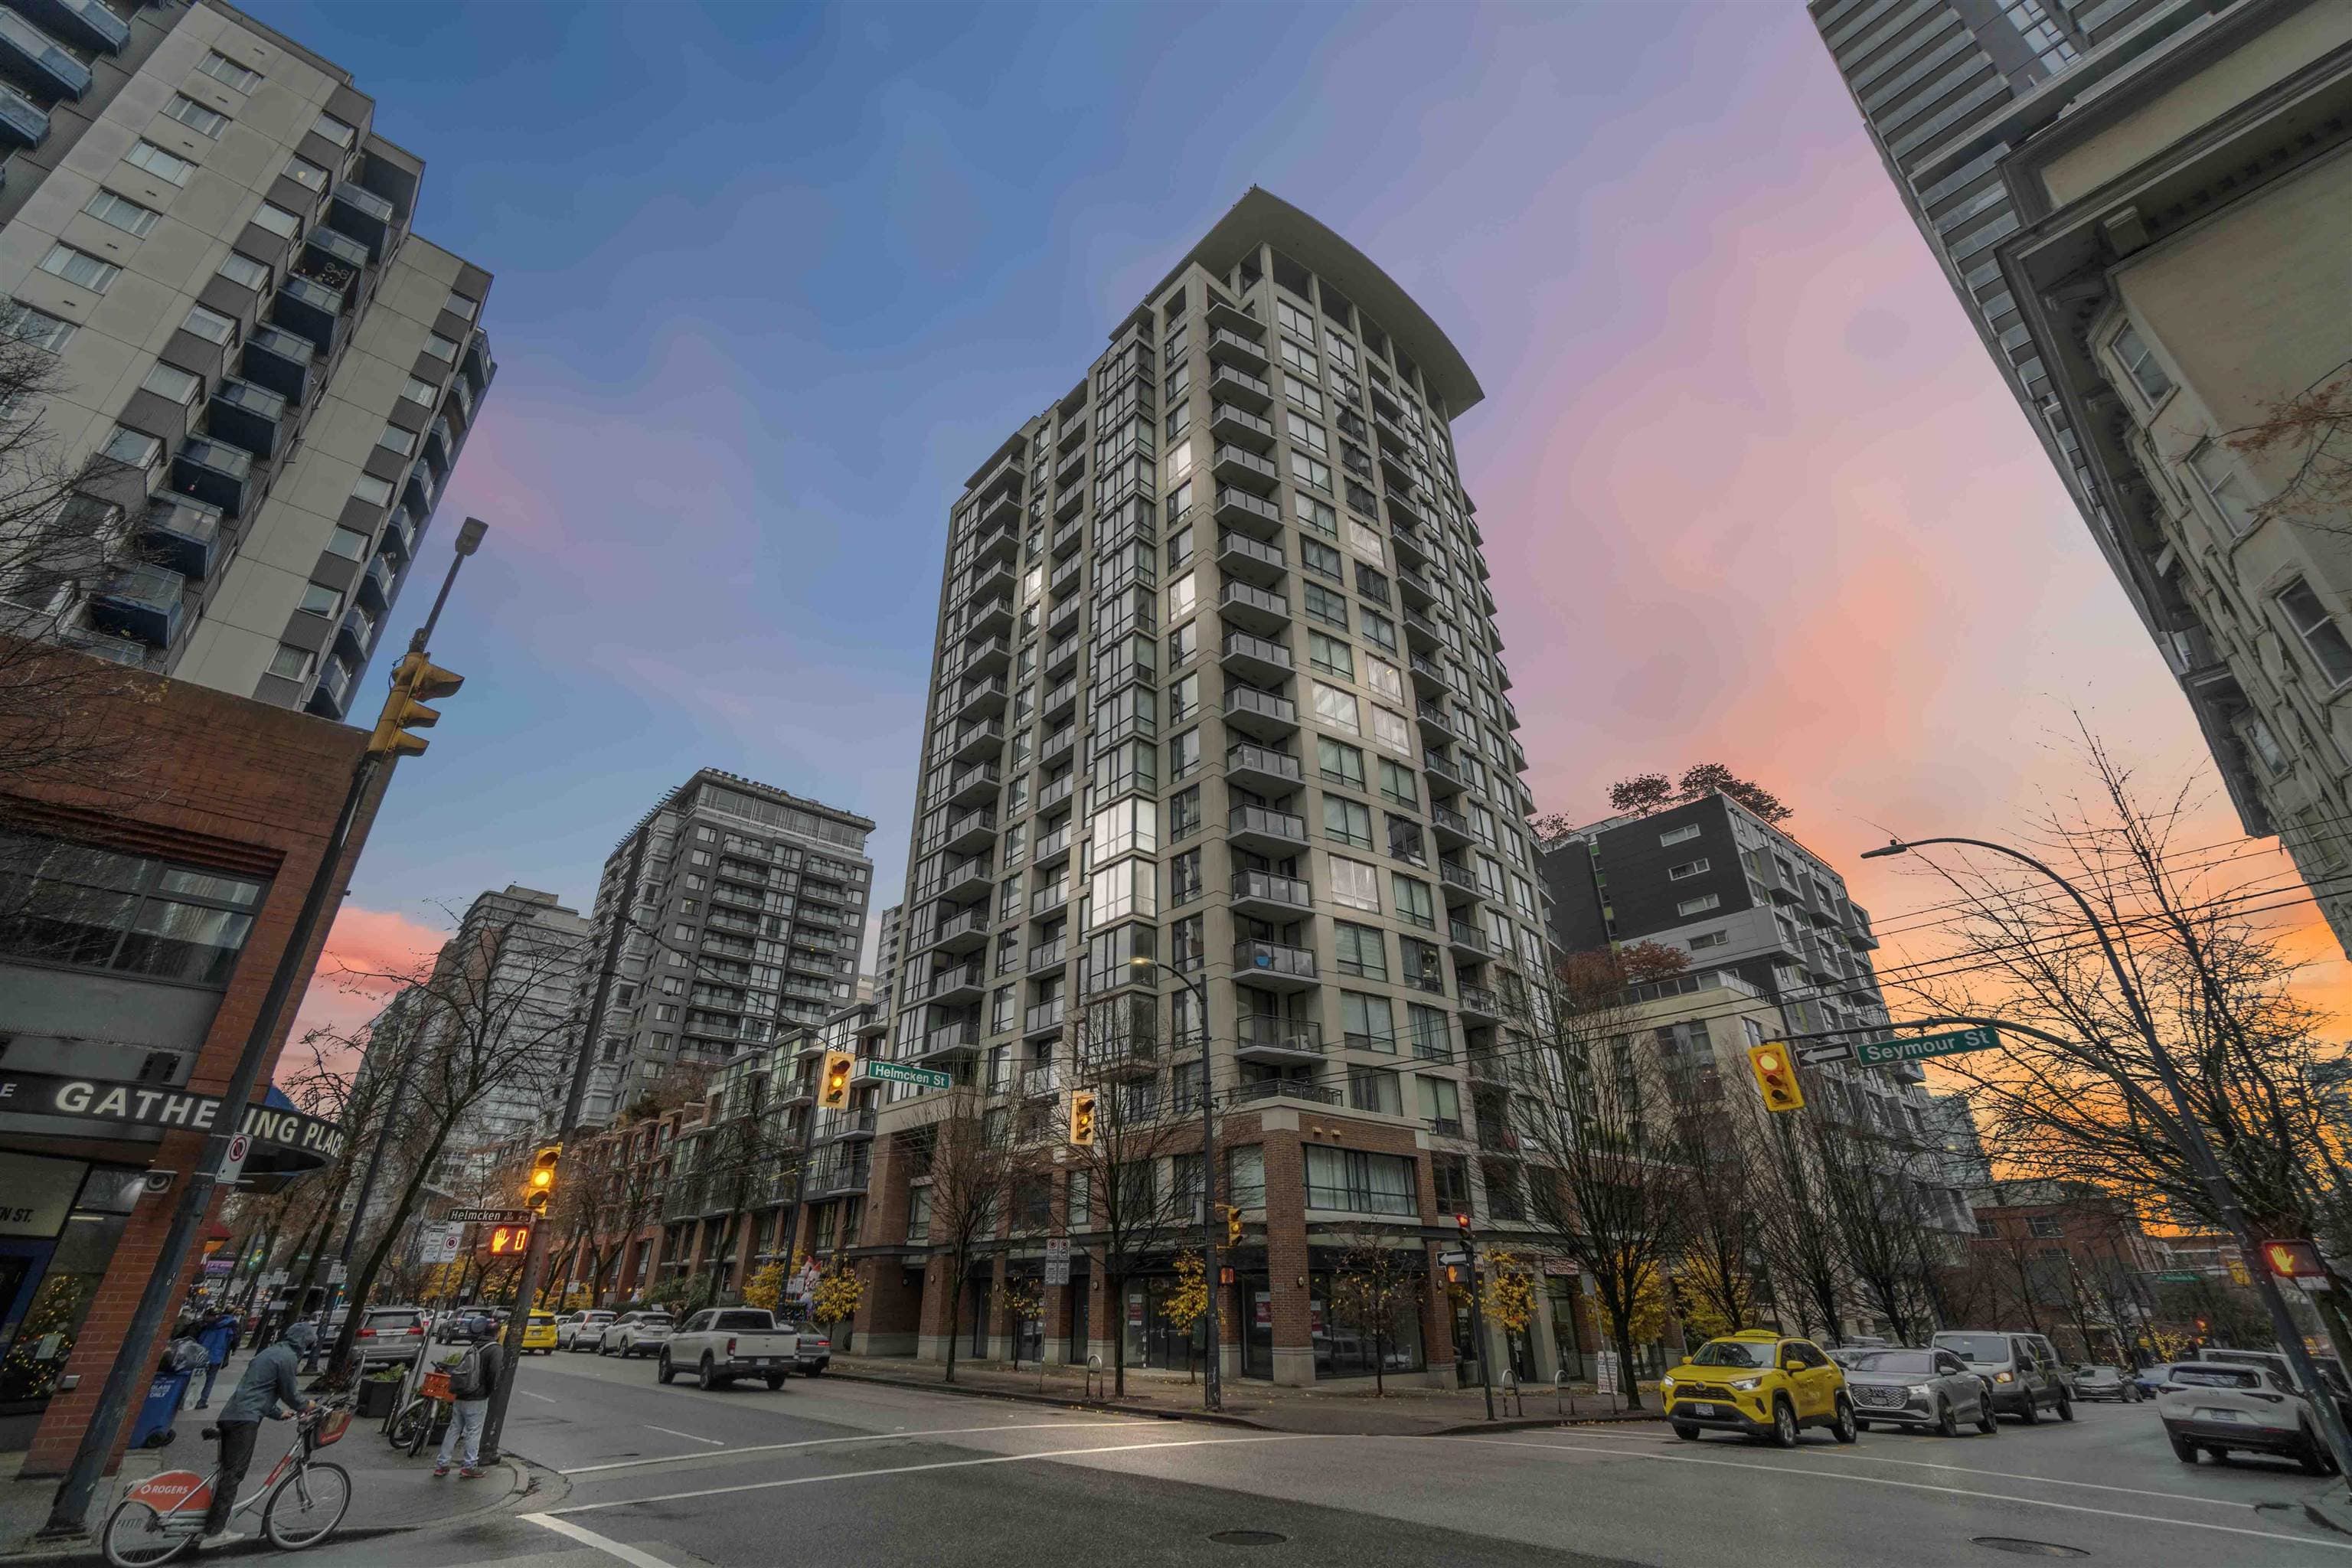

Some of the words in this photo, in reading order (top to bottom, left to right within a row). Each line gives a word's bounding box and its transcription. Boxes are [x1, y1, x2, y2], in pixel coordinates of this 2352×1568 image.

[1867, 1037, 1956, 1062] Seymour
[1963, 1029, 1991, 1047] St
[875, 1065, 929, 1084] Helmcken
[933, 1073, 945, 1086] St
[55, 1081, 298, 1143] GATHEING
[12, 1207, 34, 1223] ST.
[450, 1210, 501, 1221] Helmcken
[152, 1485, 189, 1494] ROGERS
